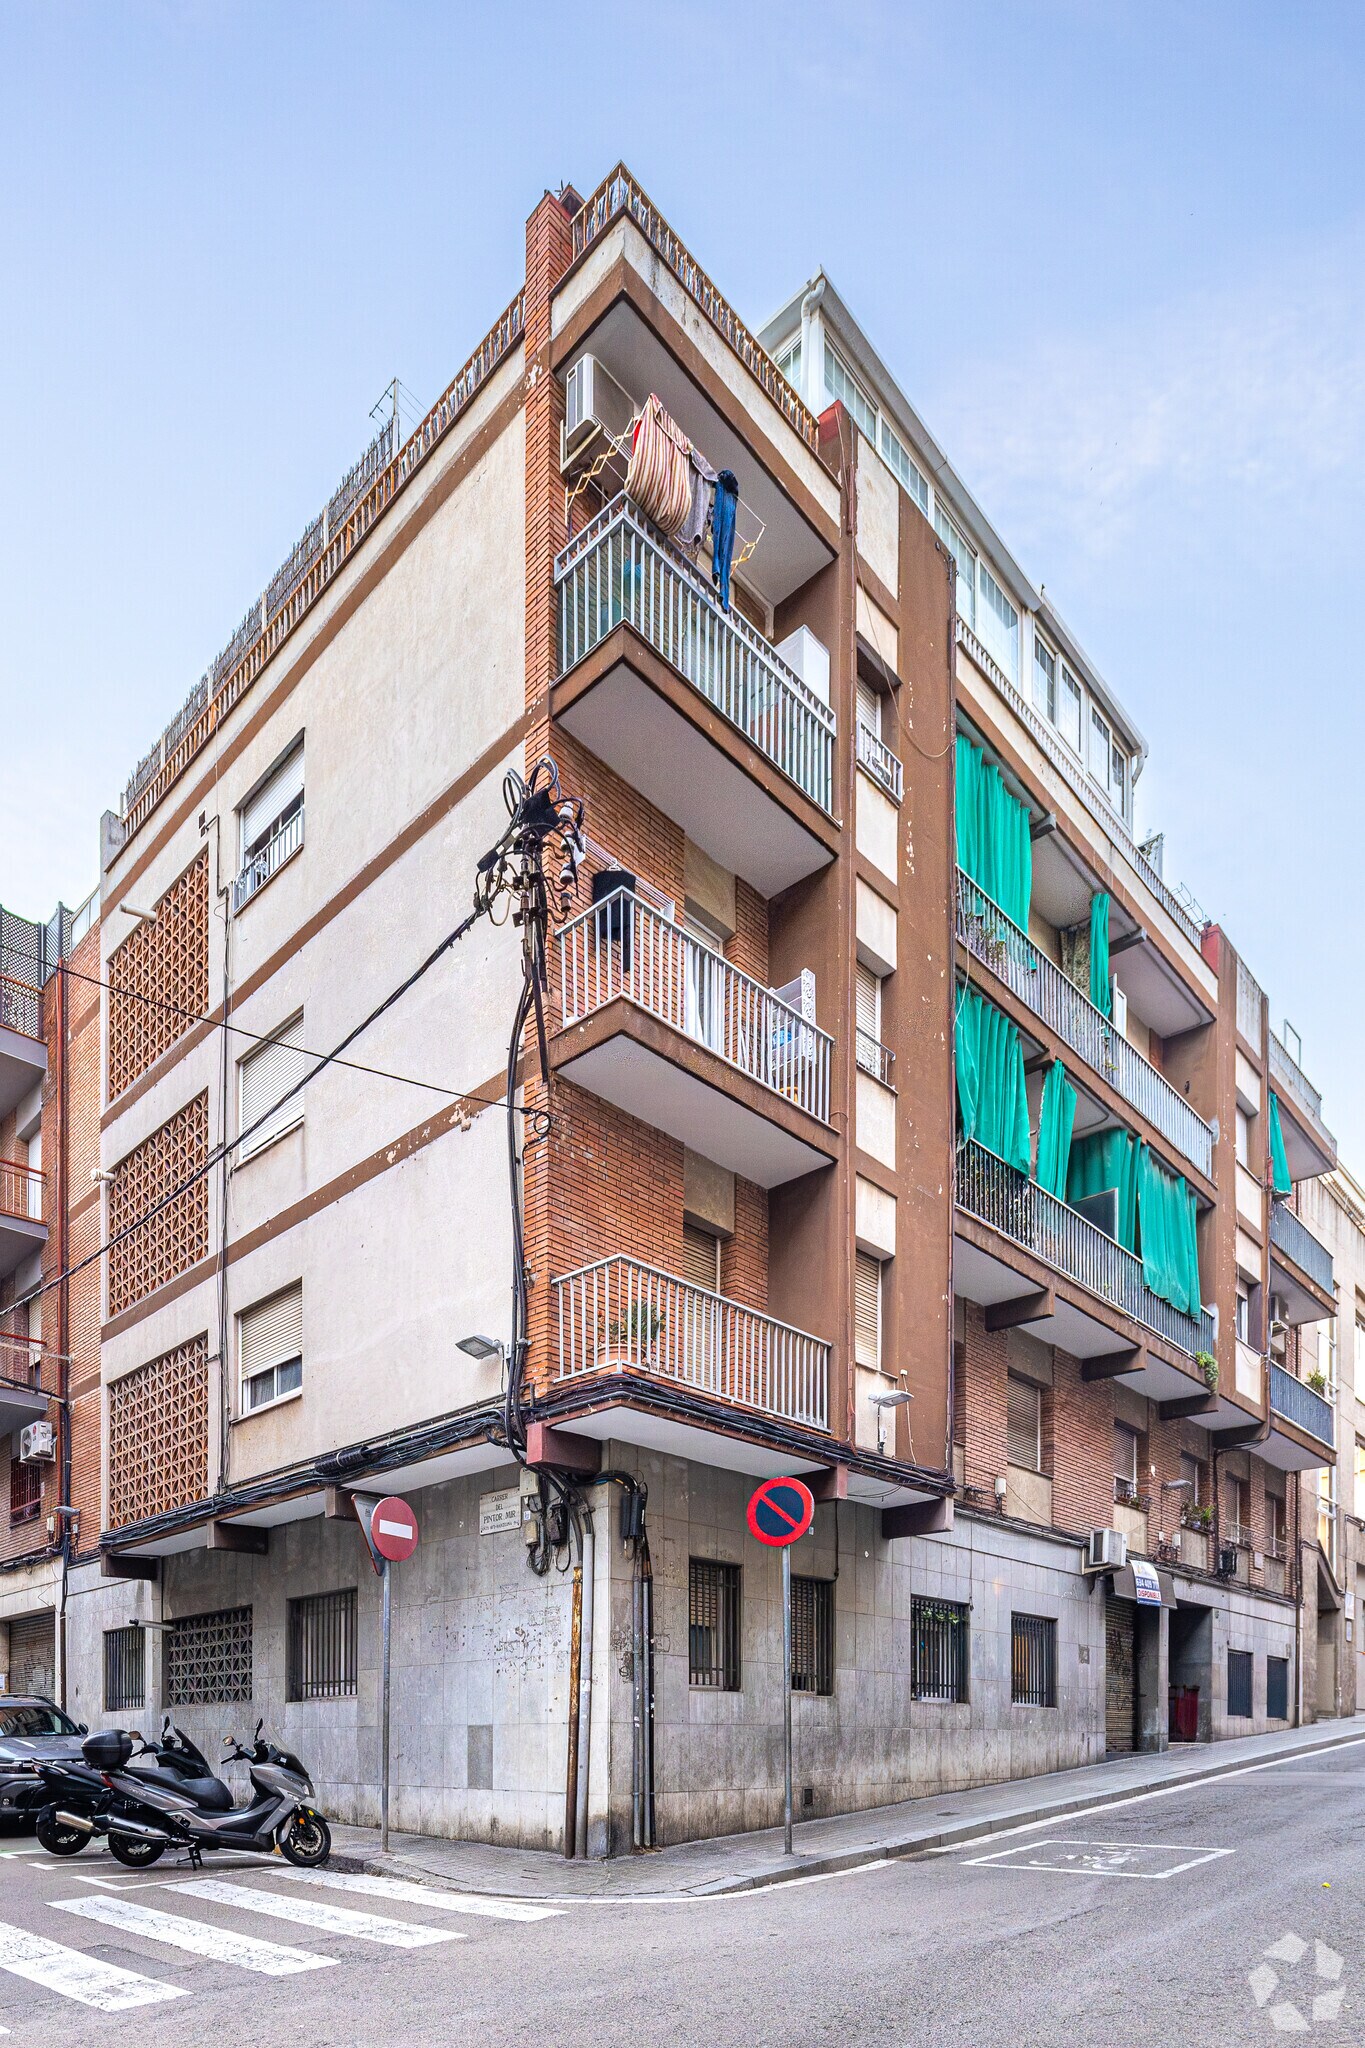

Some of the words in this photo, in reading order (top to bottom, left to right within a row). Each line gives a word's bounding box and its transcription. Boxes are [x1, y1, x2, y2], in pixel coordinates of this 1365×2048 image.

[492, 1494, 508, 1502] CARRER
[484, 1512, 502, 1524] PINTOR
[505, 1510, 516, 1519] MIR
